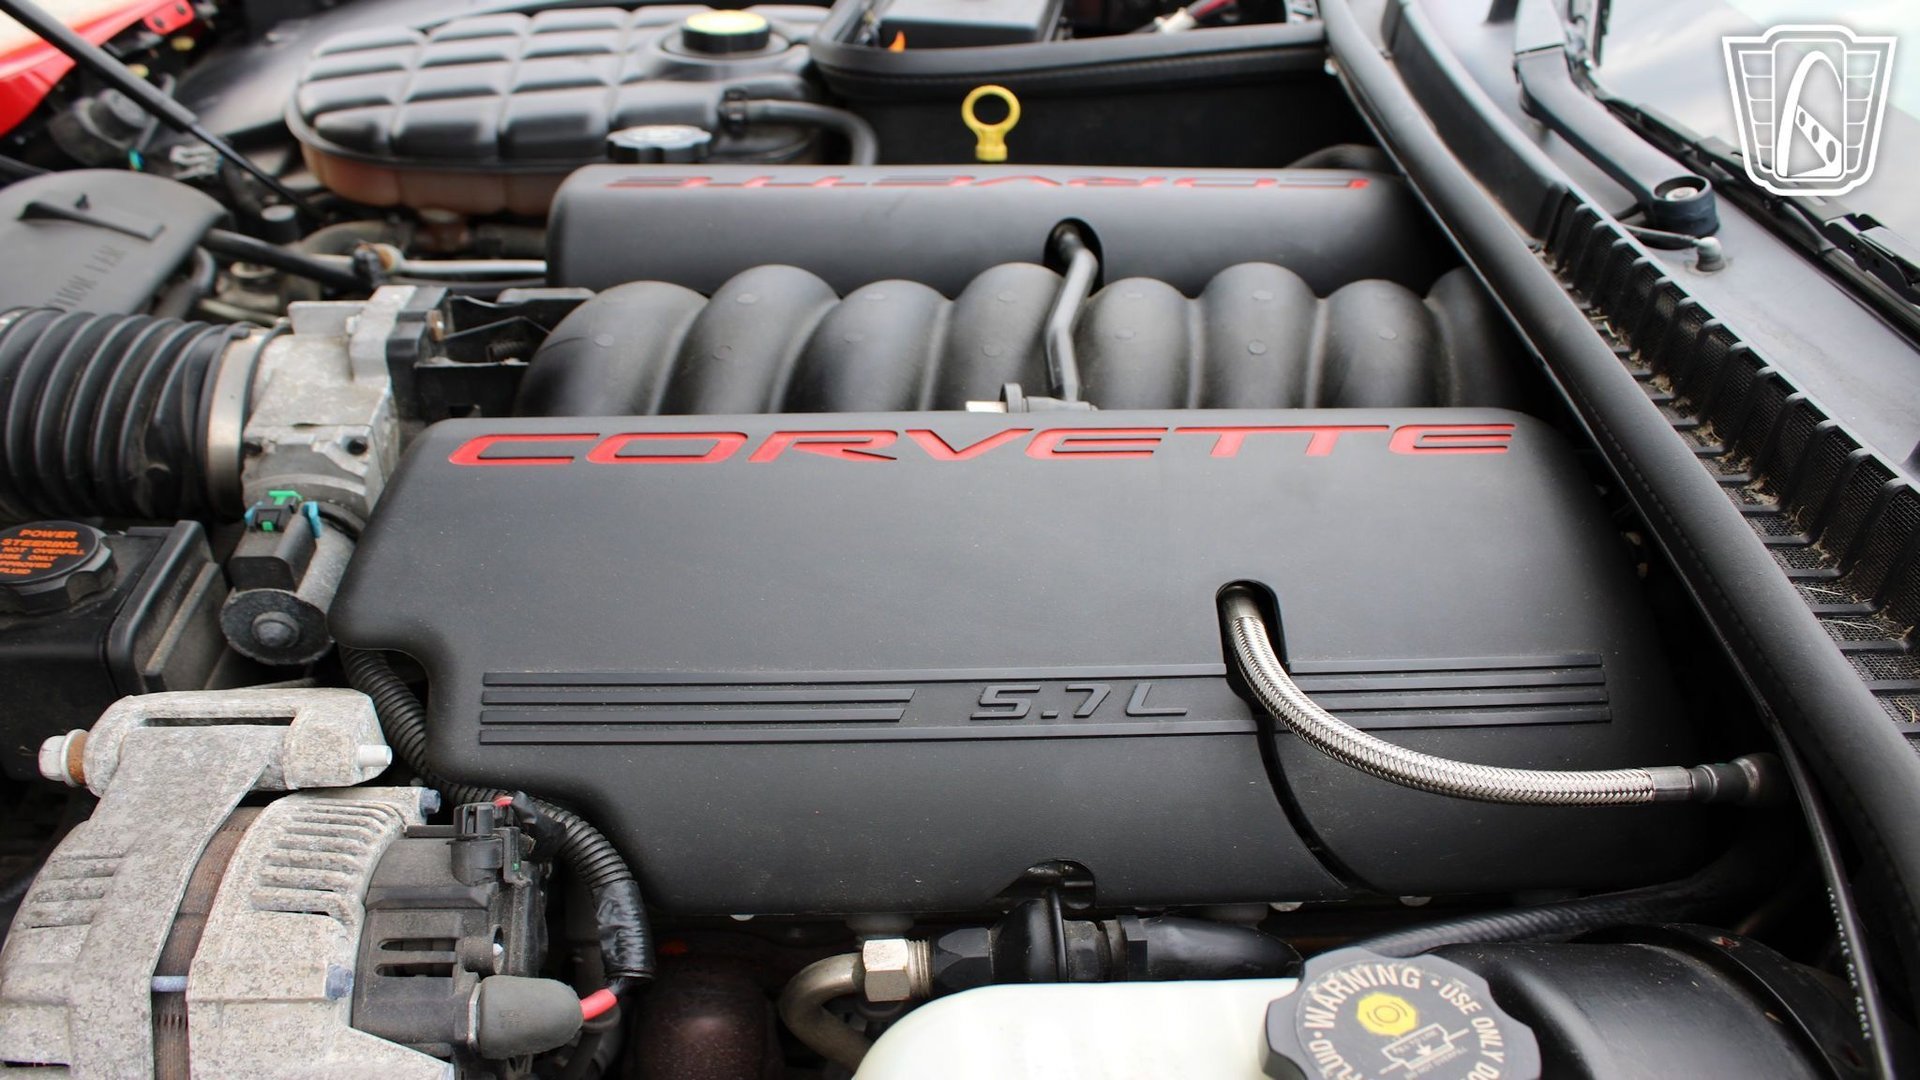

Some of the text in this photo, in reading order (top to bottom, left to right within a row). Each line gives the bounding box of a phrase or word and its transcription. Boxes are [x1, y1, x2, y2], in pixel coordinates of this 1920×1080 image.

[604, 175, 1370, 189] CORVETTE
[448, 423, 1515, 466] CORVETTE
[1, 538, 80, 549] STEERING
[19, 529, 78, 539] POWER
[970, 682, 1188, 720] 5.7L
[1304, 965, 1421, 1029] WARNING
[1439, 983, 1483, 1015] USE
[1471, 1016, 1505, 1063] ONLY
